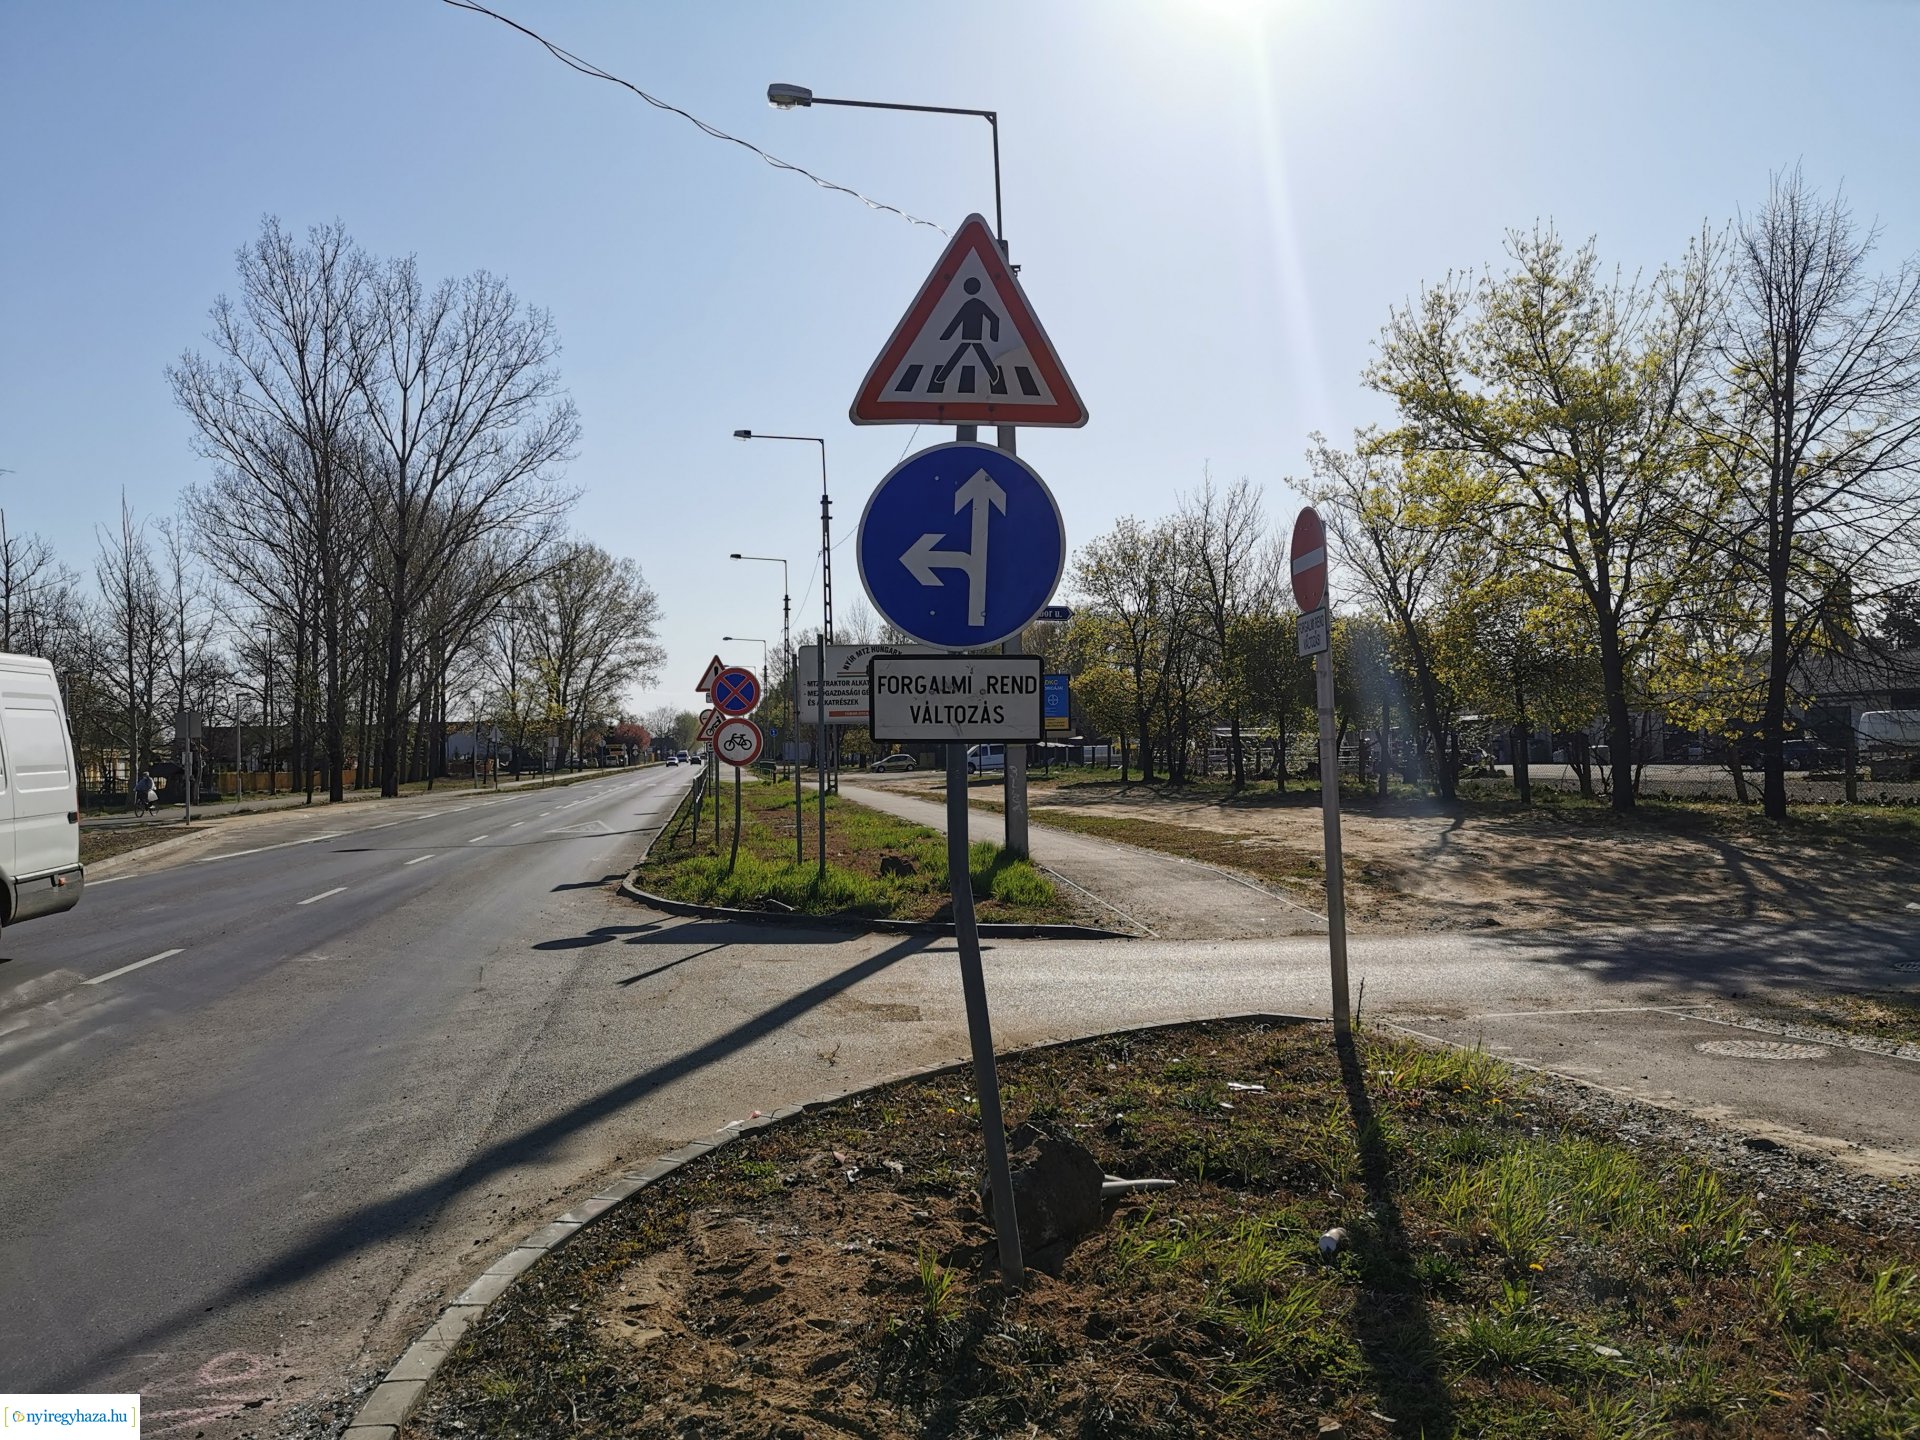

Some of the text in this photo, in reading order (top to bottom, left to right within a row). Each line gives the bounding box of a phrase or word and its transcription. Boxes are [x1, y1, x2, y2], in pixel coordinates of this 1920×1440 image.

[842, 654, 856, 671] NYÍR
[855, 646, 870, 658] MTZ
[807, 687, 860, 697] MEZGAZDASÁGI
[878, 675, 1037, 695] FORGALMI REND
[807, 697, 859, 707] ÉS KATRÉSZEK
[910, 700, 1005, 725] VÁLTOZÁS
